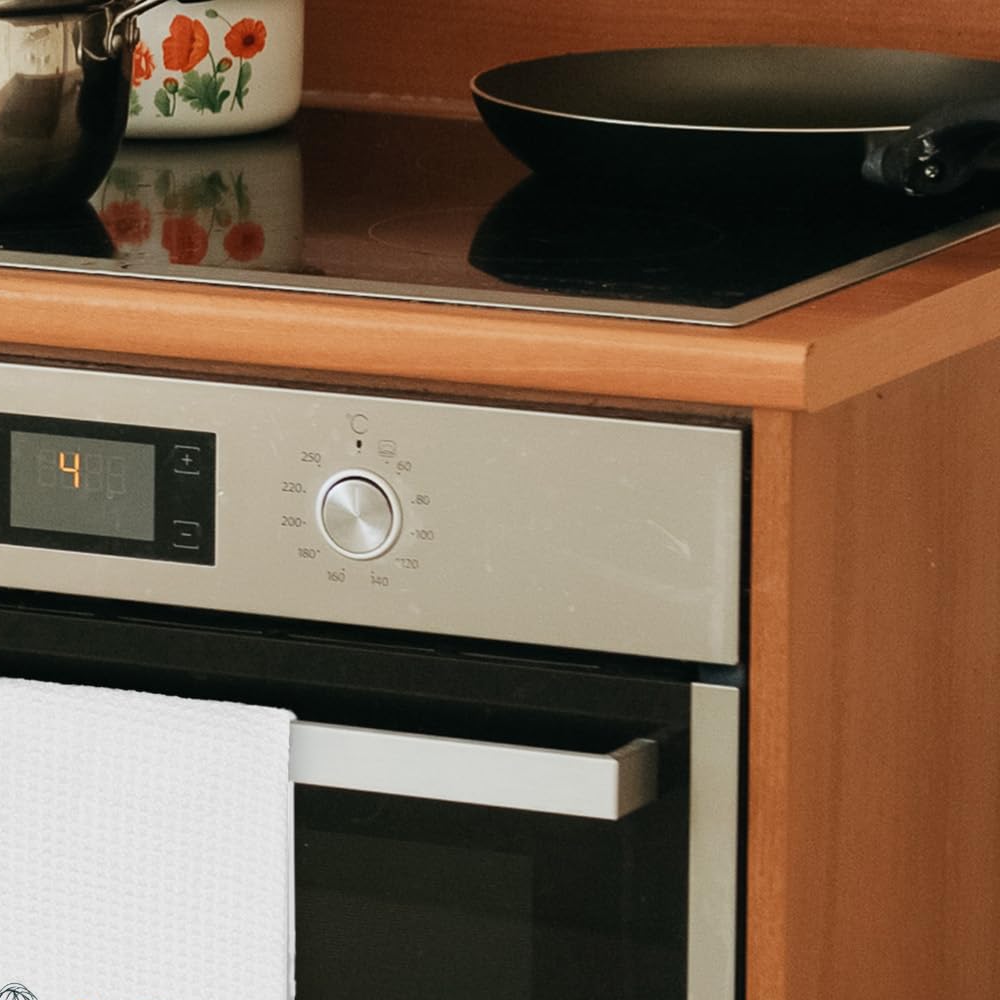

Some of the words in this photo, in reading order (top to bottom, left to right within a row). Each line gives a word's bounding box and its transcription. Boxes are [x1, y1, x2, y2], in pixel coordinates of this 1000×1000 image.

[301, 451, 322, 464] 250
[58, 451, 81, 489] 4
[281, 481, 303, 494] 220
[281, 515, 302, 528] 200
